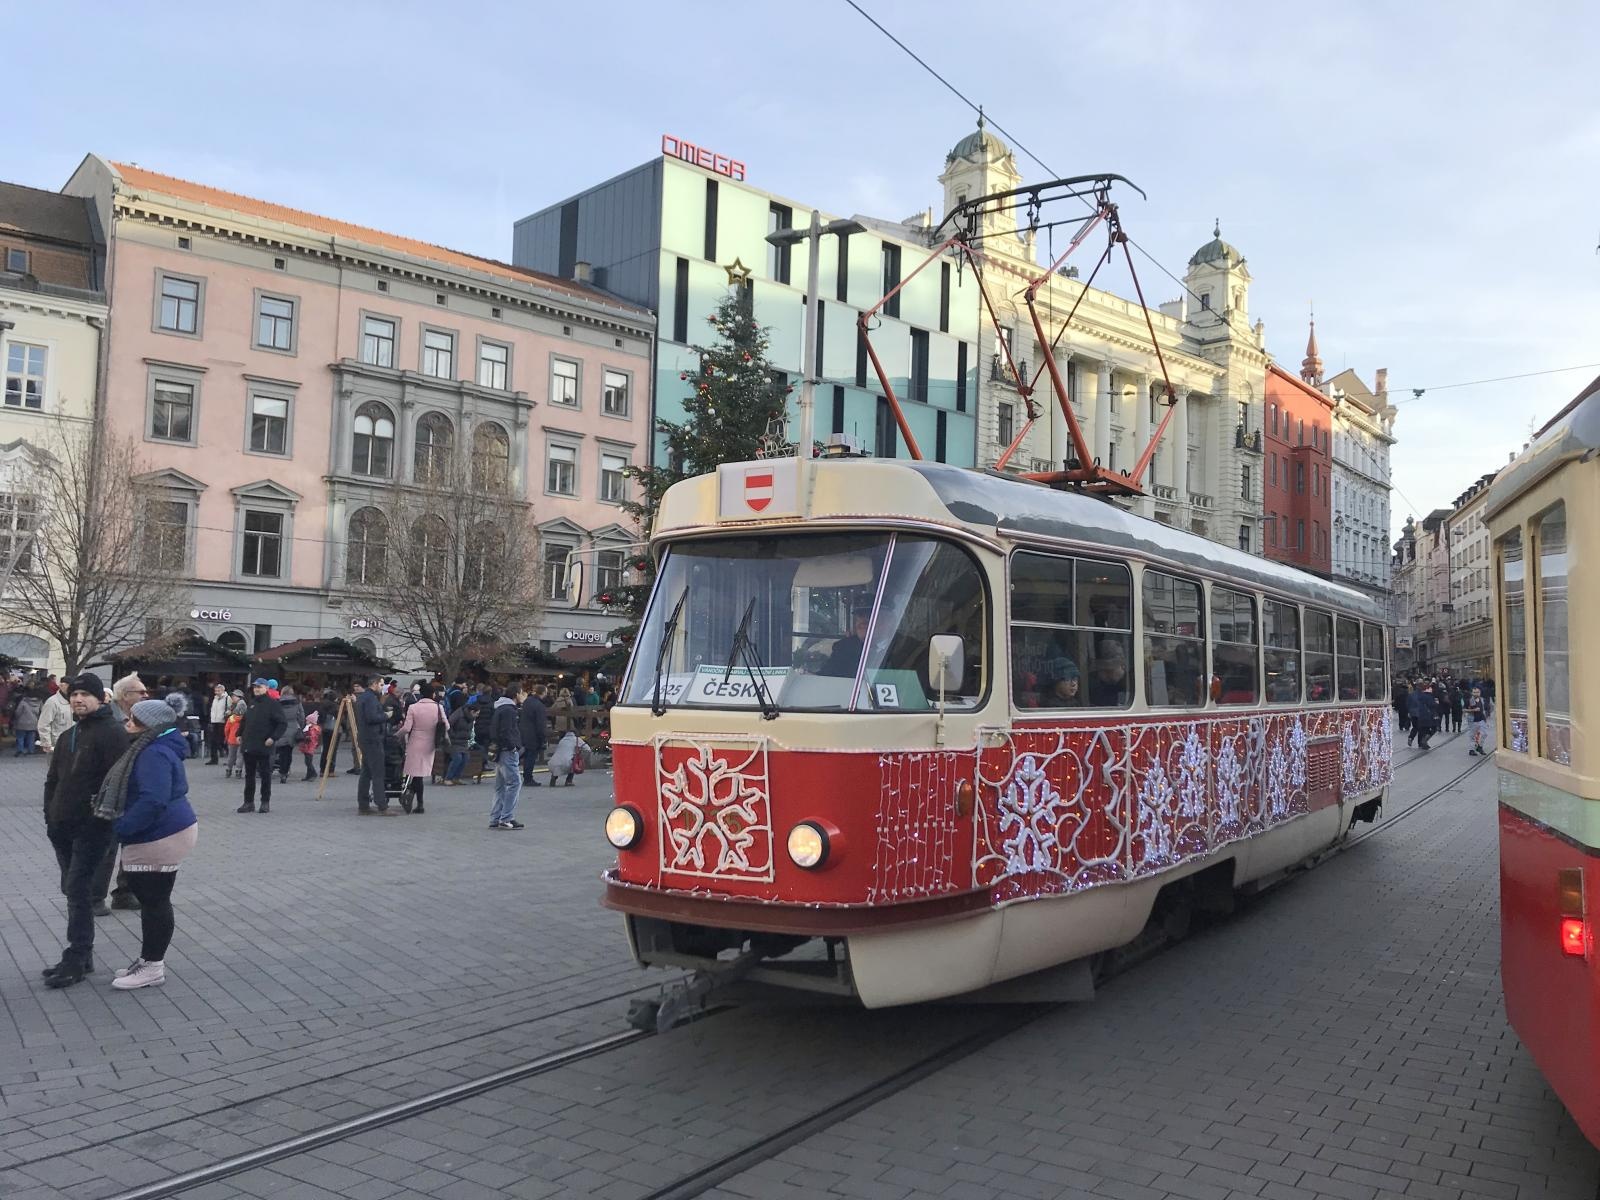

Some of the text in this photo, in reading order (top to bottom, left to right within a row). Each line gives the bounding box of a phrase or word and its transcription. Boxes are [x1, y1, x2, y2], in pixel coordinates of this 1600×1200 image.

[662, 134, 745, 181] OMEGA
[200, 608, 232, 620] café
[881, 687, 894, 703] 2
